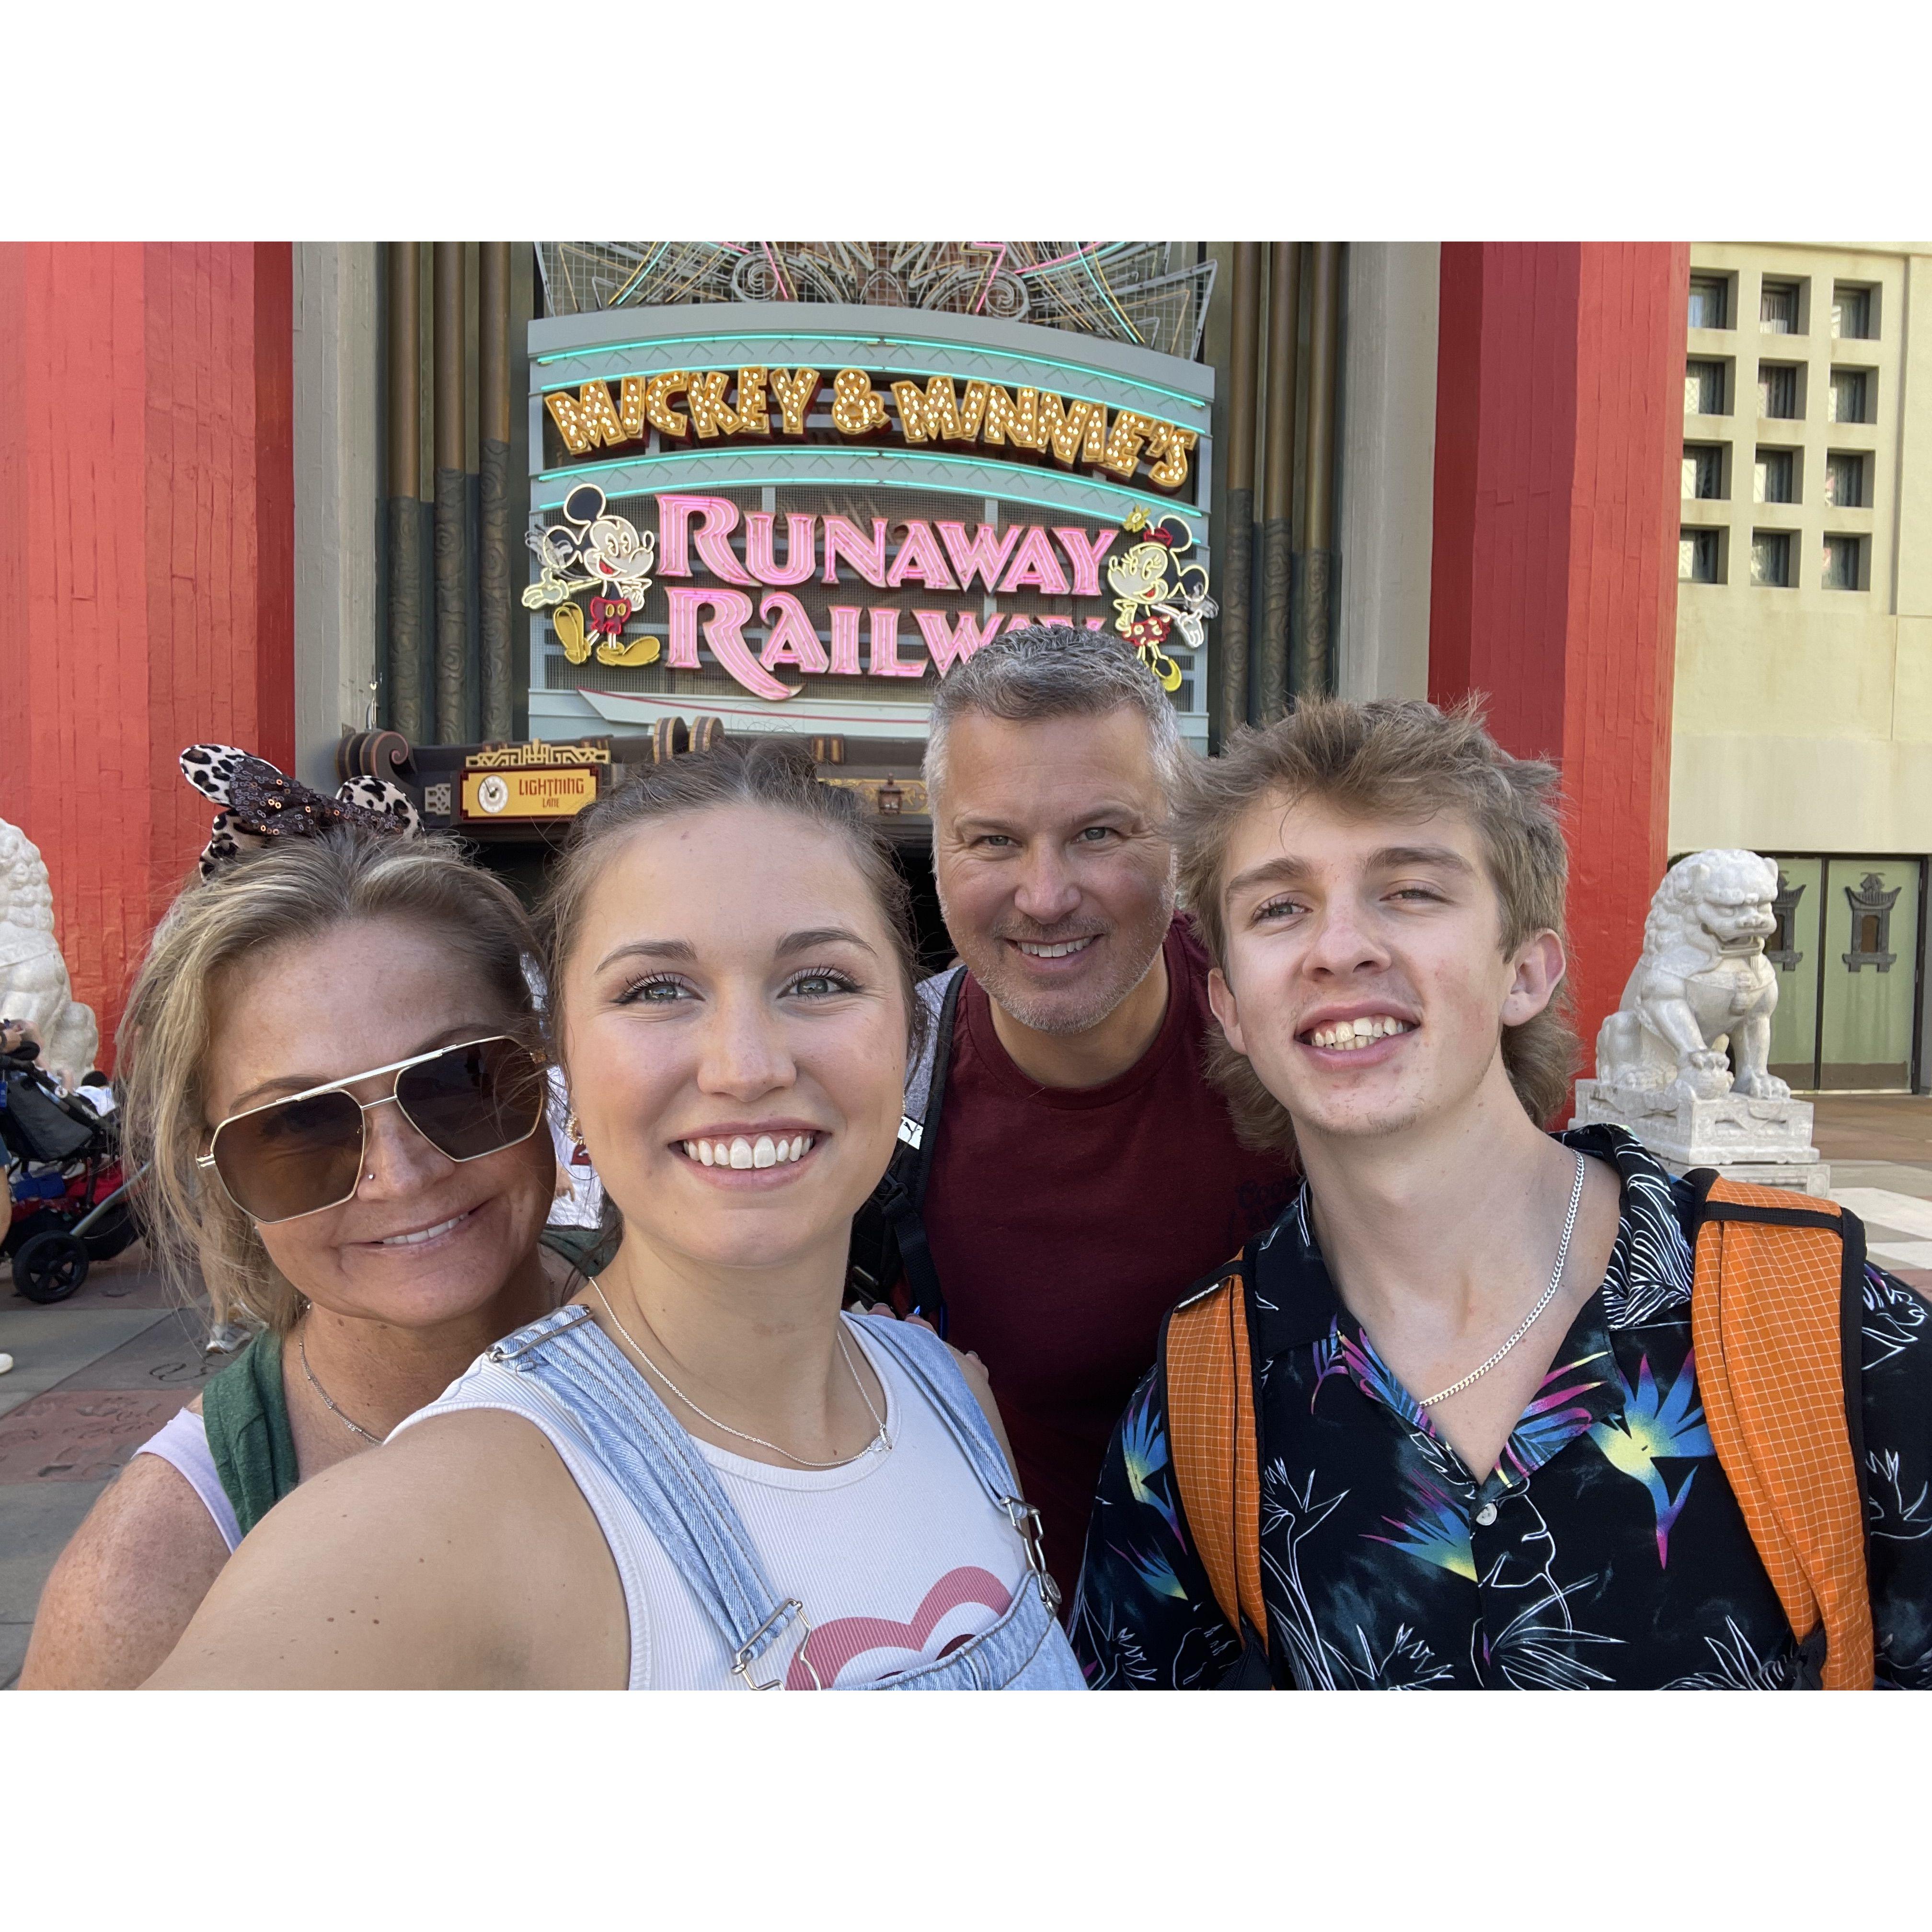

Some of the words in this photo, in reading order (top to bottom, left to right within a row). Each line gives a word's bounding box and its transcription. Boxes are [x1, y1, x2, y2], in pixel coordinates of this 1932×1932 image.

[544, 366, 820, 455] MICKEY
[831, 368, 892, 434] &
[891, 375, 1197, 487] MINNIE'S
[655, 494, 1119, 596] RUNAWAY
[663, 586, 1107, 701] RAILW
[519, 777, 584, 796] LIGHTNING
[542, 797, 560, 809] LANE
